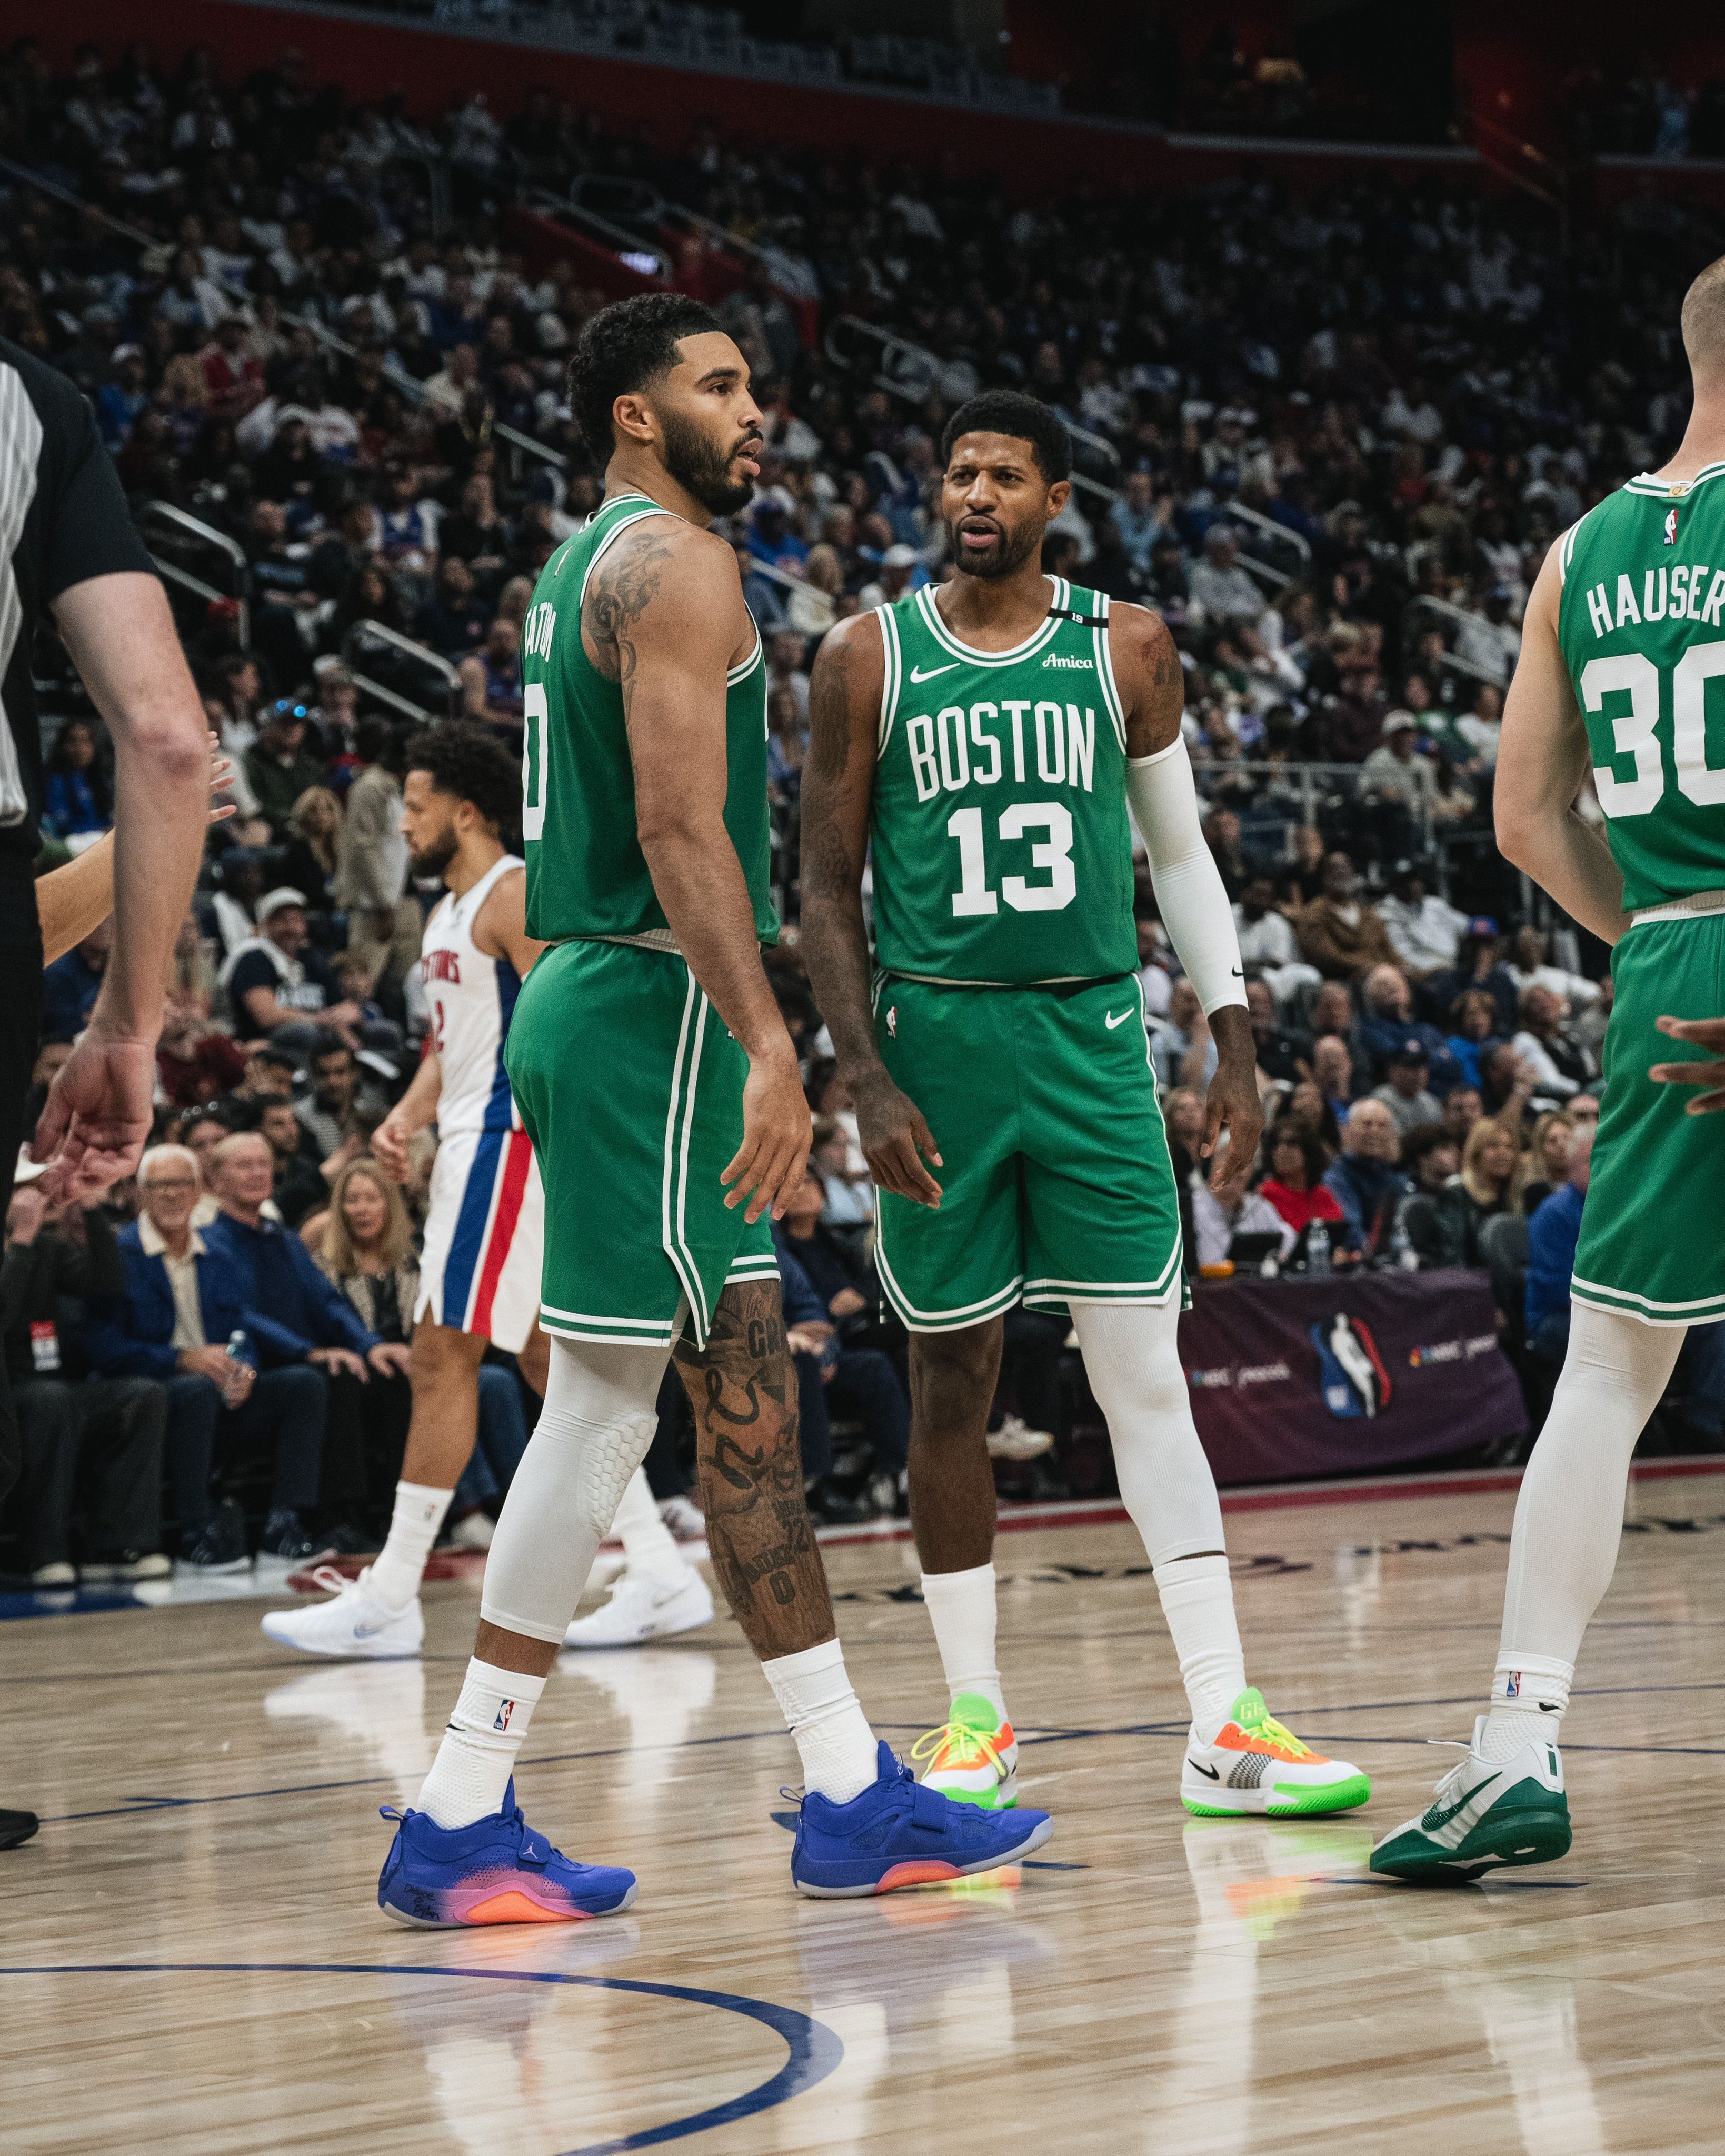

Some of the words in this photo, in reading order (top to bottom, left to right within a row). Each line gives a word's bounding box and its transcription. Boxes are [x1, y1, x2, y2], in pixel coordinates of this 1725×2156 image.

[1071, 612, 1083, 624] 19
[1586, 565, 1725, 639] HAUSER
[1042, 653, 1094, 669] Amica
[522, 683, 548, 841] 0
[905, 700, 1095, 803] BOSTON
[1580, 641, 1725, 819] 30
[947, 802, 1076, 917] 13
